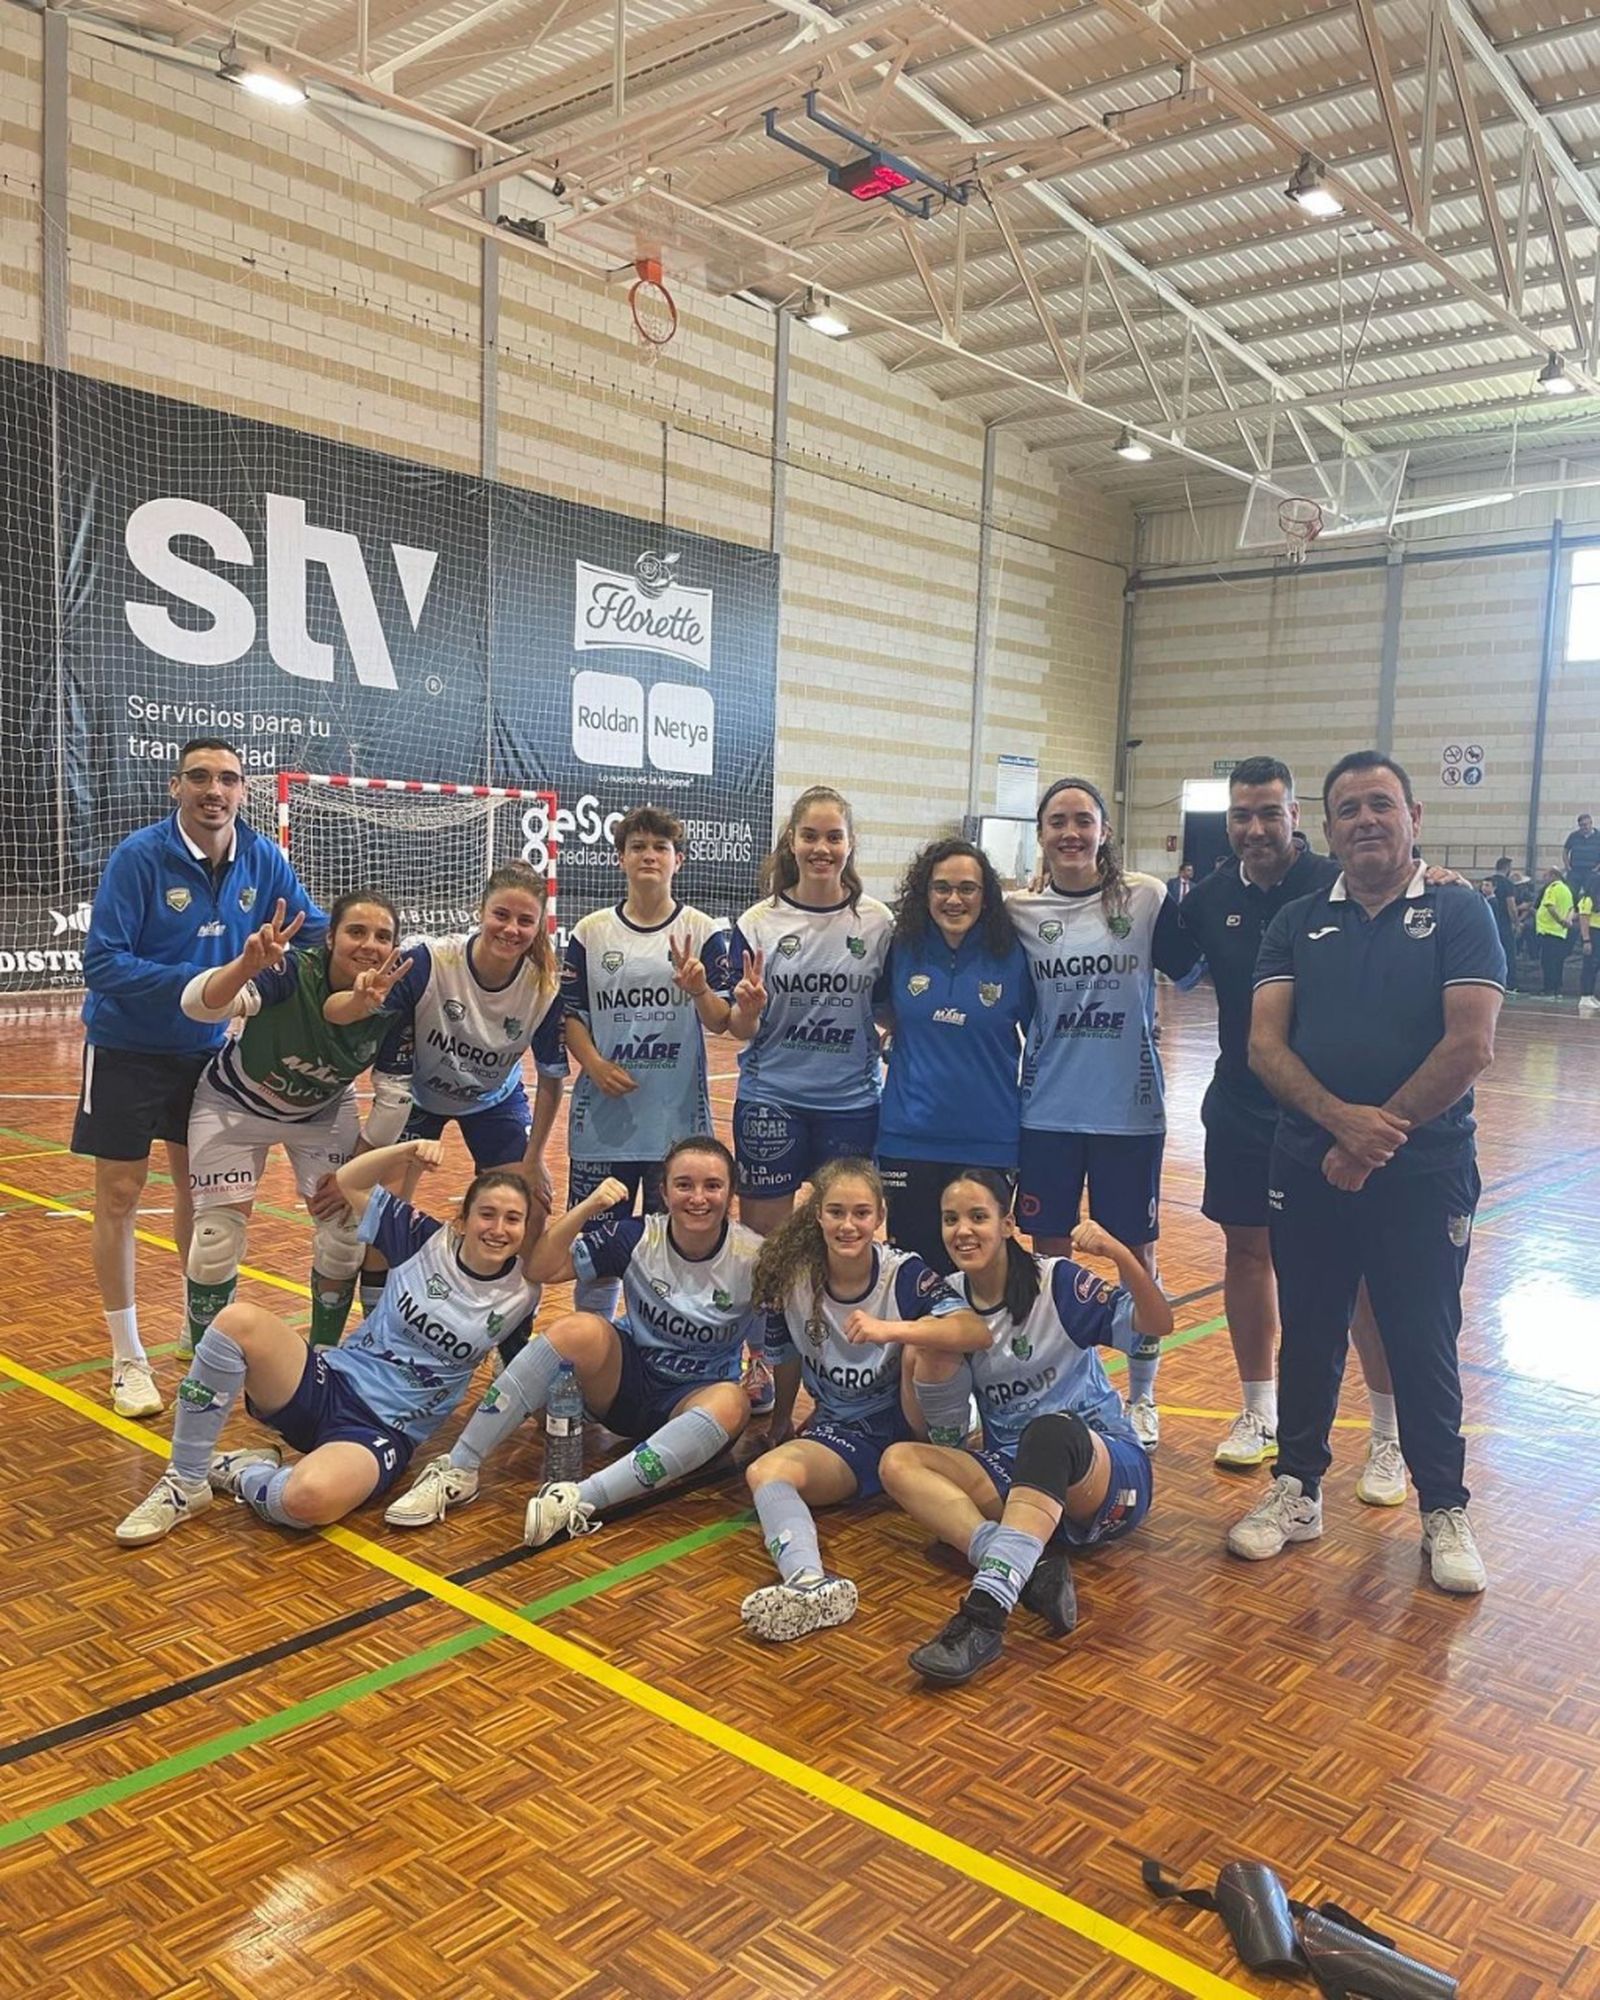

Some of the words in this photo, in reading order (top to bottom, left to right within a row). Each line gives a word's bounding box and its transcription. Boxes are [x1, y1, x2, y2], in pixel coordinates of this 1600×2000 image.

[125, 492, 439, 691] stv
[586, 582, 705, 646] Florette
[127, 694, 245, 729] Servicios
[252, 713, 302, 736] para
[309, 715, 331, 737] tu
[578, 705, 639, 734] Roldan
[654, 715, 709, 748] Netya
[127, 735, 276, 767] trandad
[679, 818, 753, 843] ORREDURÍA
[556, 847, 620, 867] mediació
[689, 841, 752, 862] SEGUROS
[0, 950, 85, 973] DISTR
[1034, 954, 1139, 981] INAGROUP
[1055, 982, 1073, 993] EL
[1076, 979, 1120, 991] EJIDO
[790, 997, 807, 1007] EL
[810, 996, 854, 1008] EJIDO
[613, 1012, 633, 1023] EL
[634, 1010, 677, 1022] EJIDO
[750, 1164, 767, 1175] La
[1148, 1197, 1157, 1228] 9
